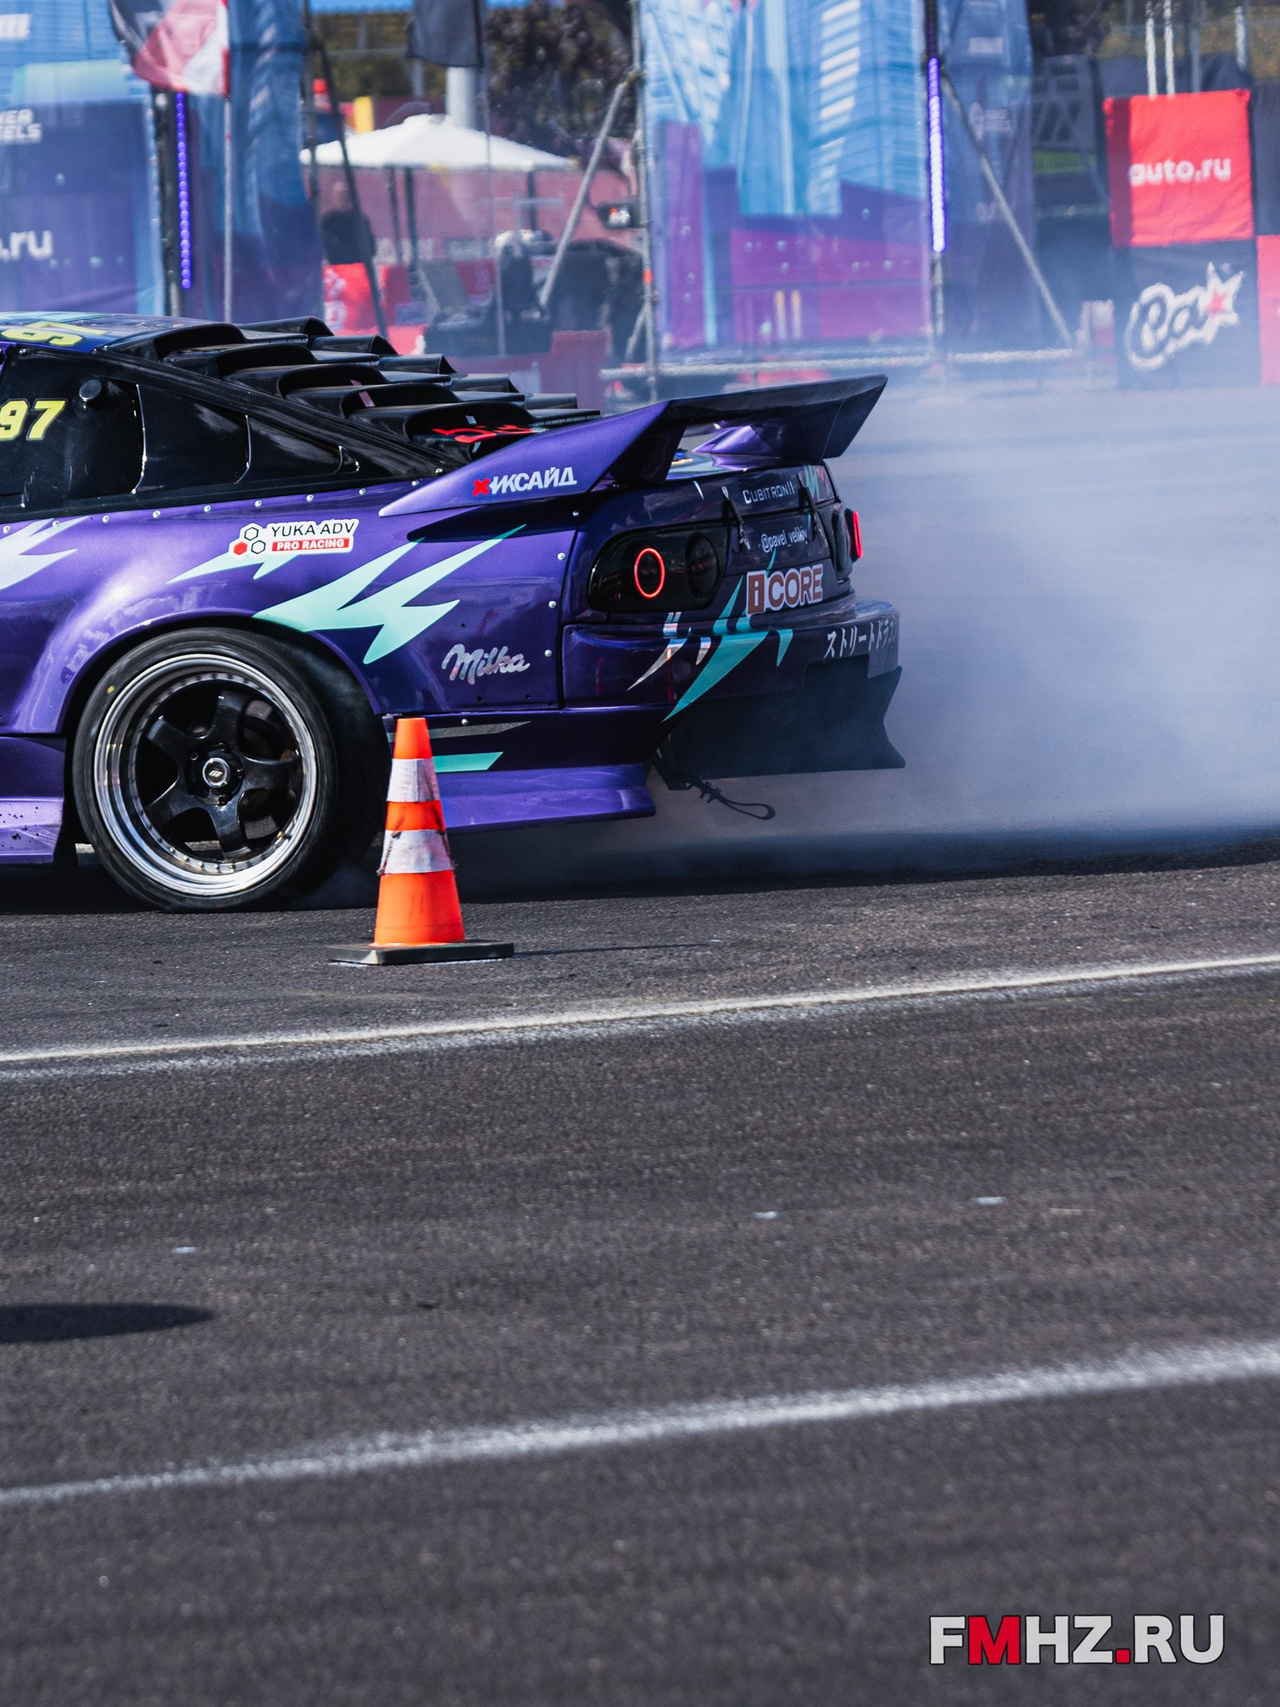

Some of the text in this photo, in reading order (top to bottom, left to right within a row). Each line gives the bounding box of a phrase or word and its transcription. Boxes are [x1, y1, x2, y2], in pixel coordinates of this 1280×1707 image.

[1128, 157, 1232, 186] auto.ru
[271, 521, 355, 538] YUKA ADV
[276, 538, 345, 551] PRO RACING
[441, 643, 531, 685] Milka
